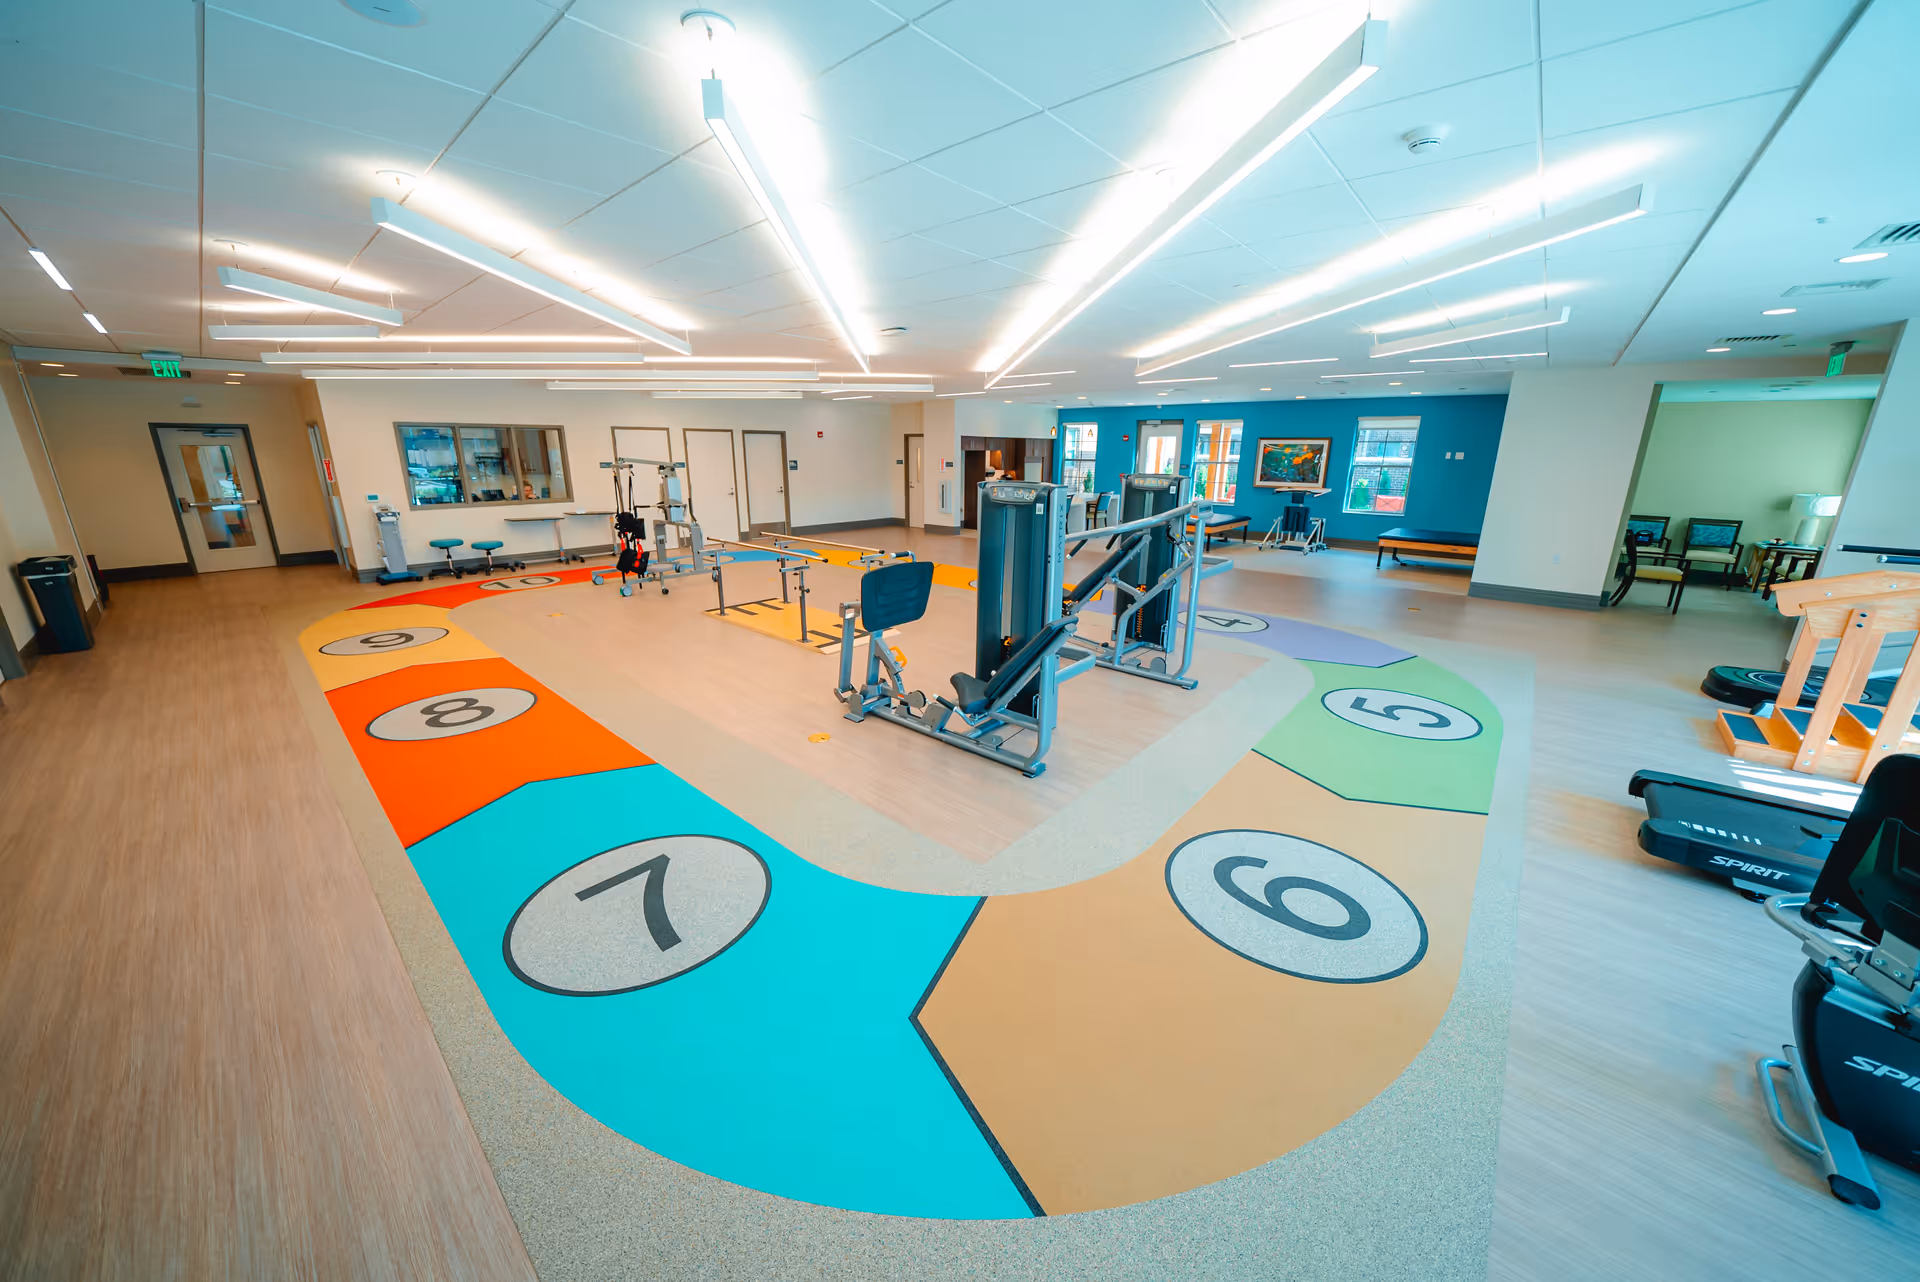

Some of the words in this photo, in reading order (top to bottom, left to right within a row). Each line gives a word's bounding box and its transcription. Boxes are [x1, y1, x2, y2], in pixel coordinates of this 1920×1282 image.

[150, 360, 182, 378] EXIT
[484, 576, 556, 589] 10
[1197, 614, 1252, 628] 4
[359, 632, 415, 648] 9
[420, 697, 495, 728] 8
[1350, 696, 1452, 729] 5
[1709, 855, 1791, 880] SPIRIT
[574, 853, 682, 952] 7
[1213, 855, 1372, 941] 6
